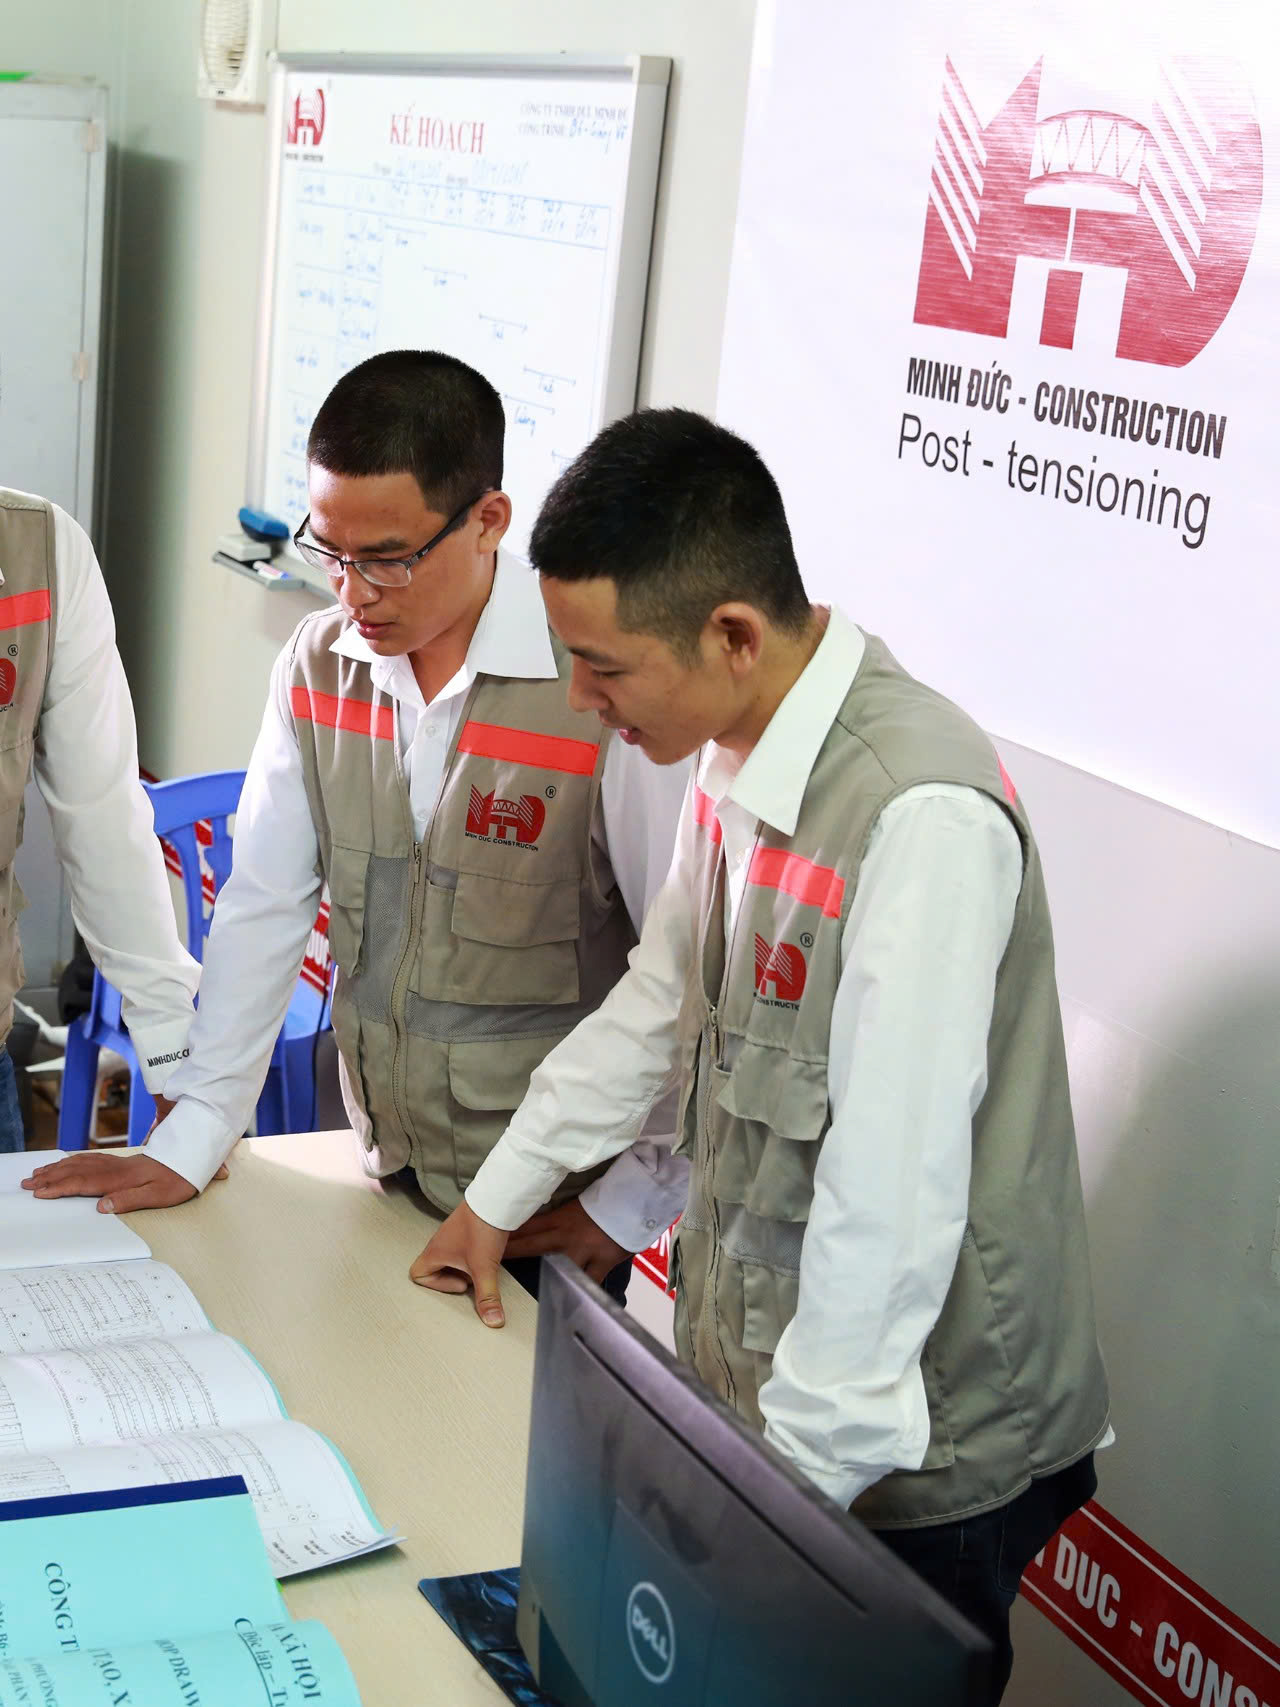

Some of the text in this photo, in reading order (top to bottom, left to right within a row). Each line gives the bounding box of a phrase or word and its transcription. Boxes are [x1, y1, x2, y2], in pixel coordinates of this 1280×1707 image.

[907, 357, 962, 404] MINH
[966, 360, 1012, 414] ĐỨC
[1034, 381, 1227, 459] CONSTRUCTION
[898, 413, 972, 476] Post
[1007, 440, 1211, 549] tensioning
[44, 1562, 74, 1631] CÔNG
[1053, 1533, 1120, 1628] DUC
[1153, 1621, 1280, 1707] CON
[291, 1658, 322, 1699] HỘI
